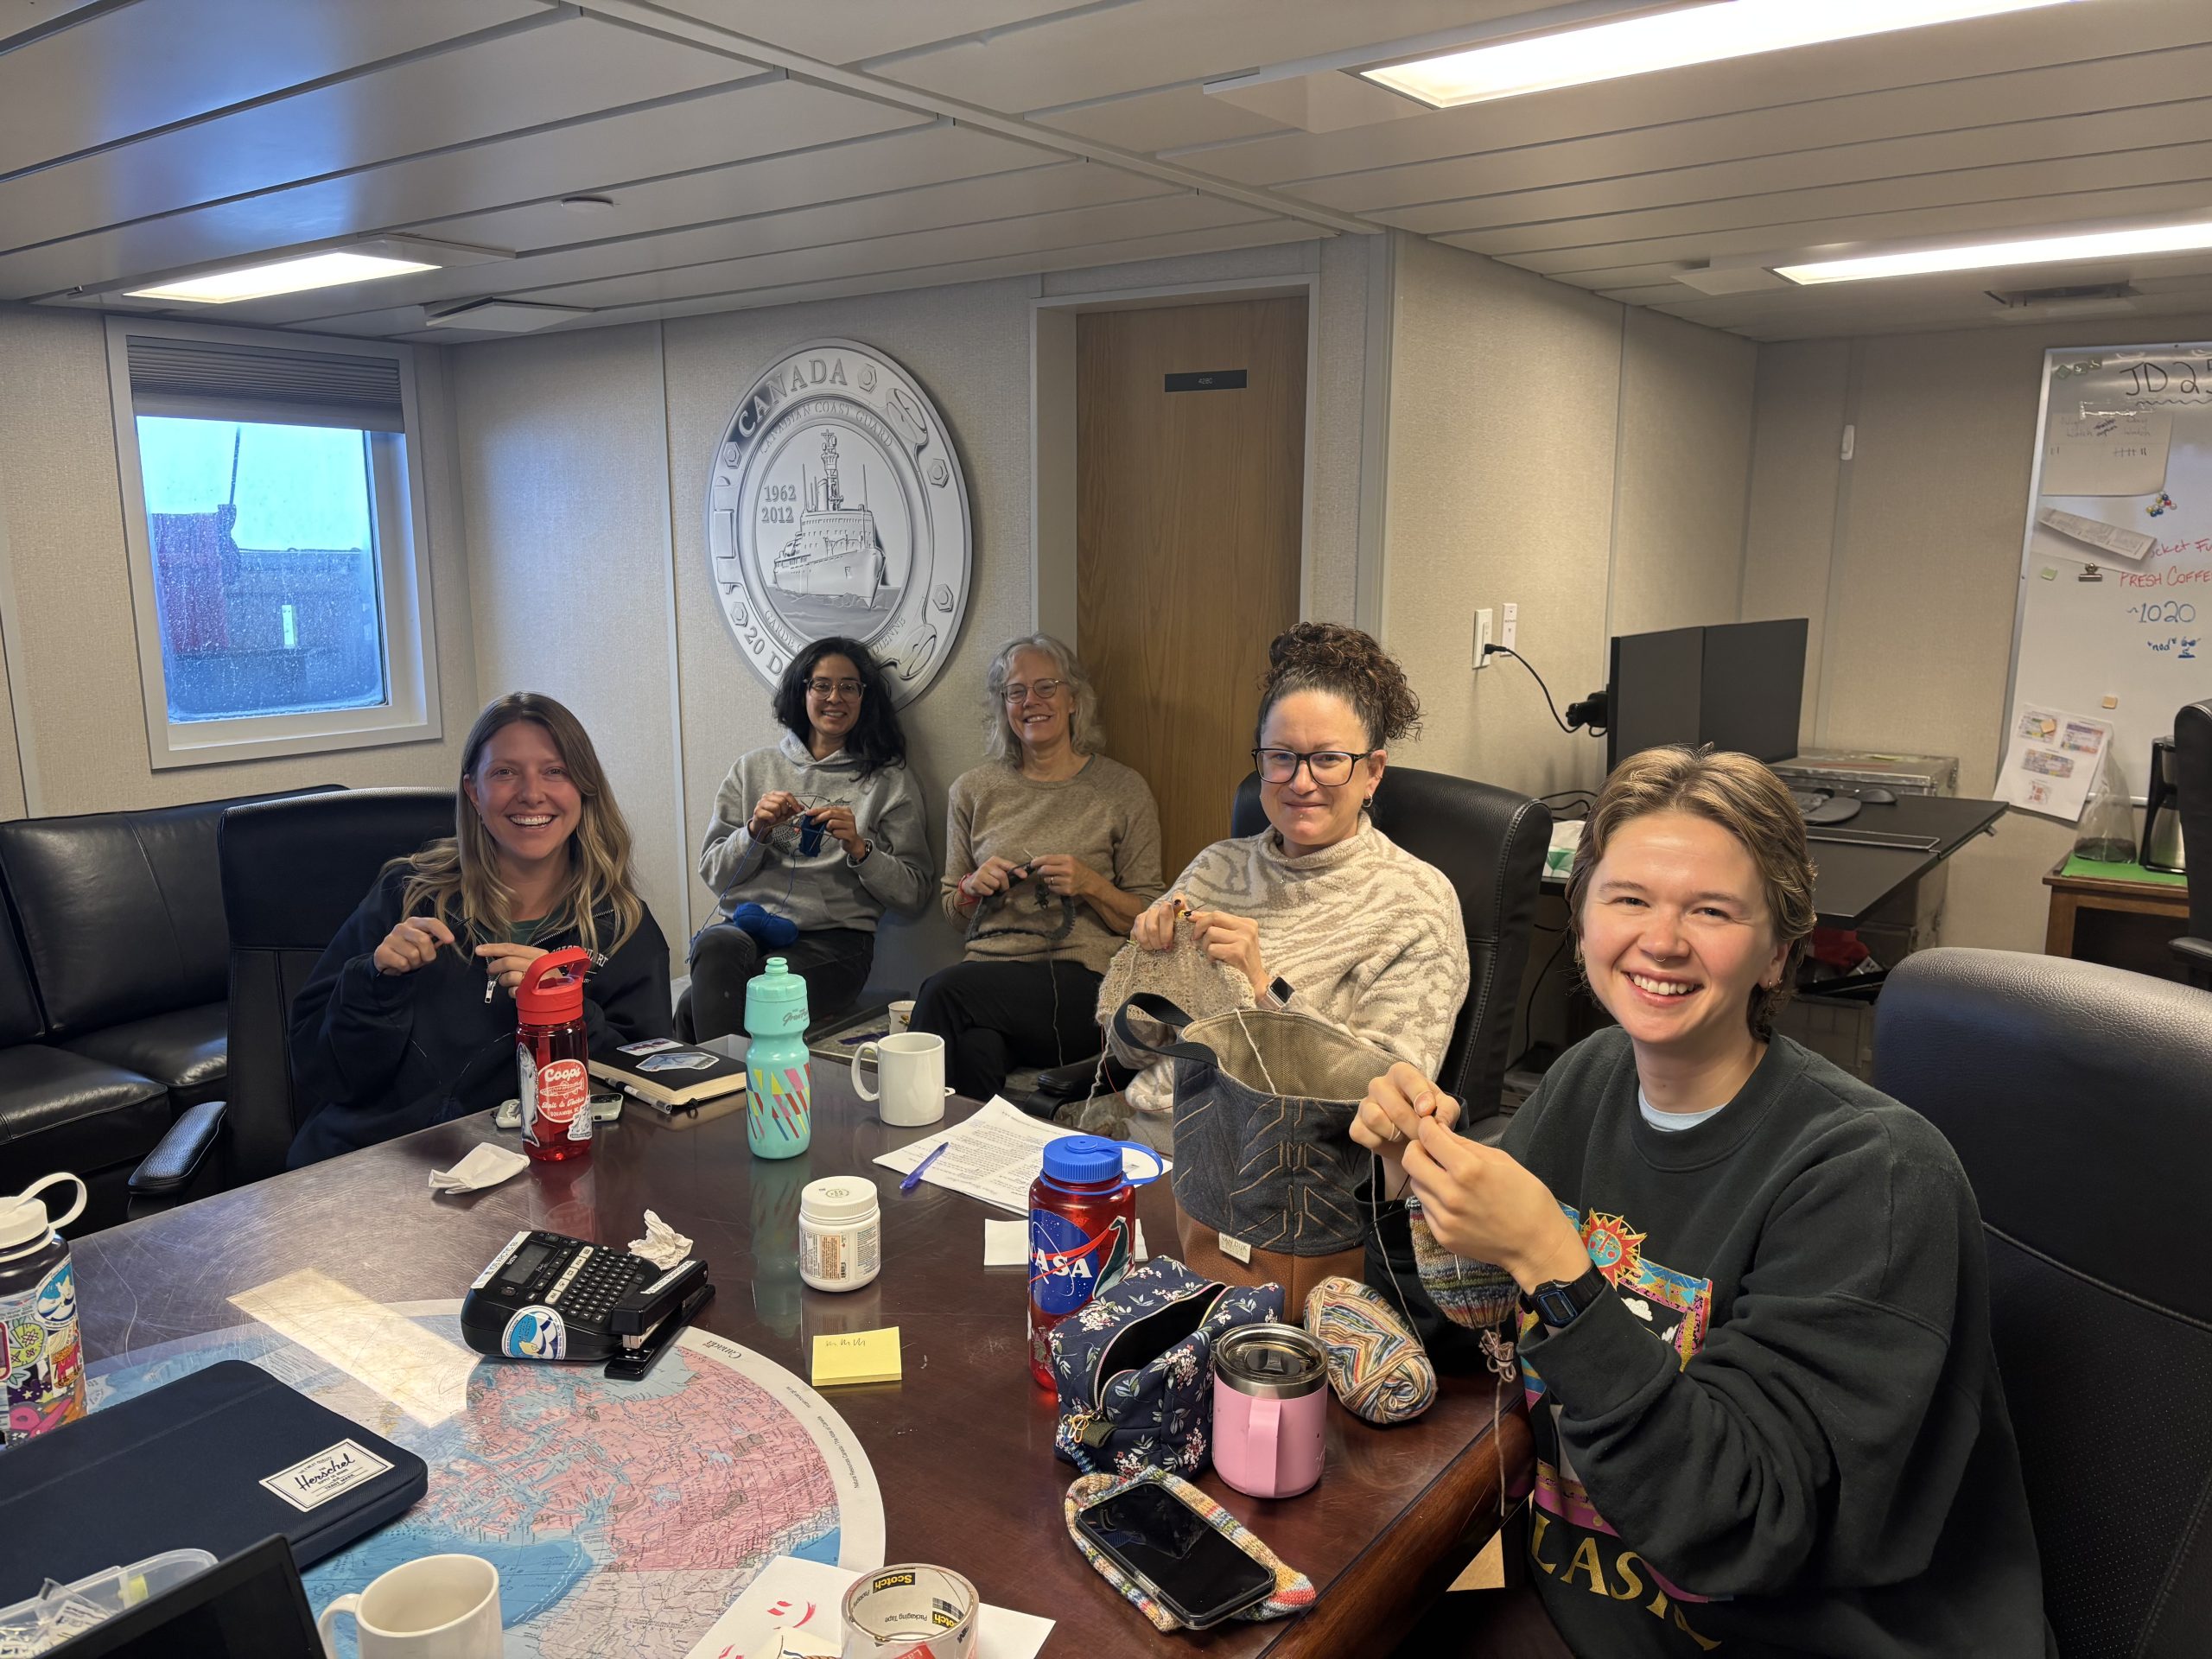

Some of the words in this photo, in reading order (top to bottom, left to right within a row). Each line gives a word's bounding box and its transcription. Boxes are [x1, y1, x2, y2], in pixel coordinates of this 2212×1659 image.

[738, 358, 848, 437] CANADA
[760, 404, 810, 454] CANADIAN
[815, 401, 851, 416] COAST
[855, 410, 893, 448] GUARD
[764, 484, 797, 503] 1962
[761, 505, 795, 524] 2012
[765, 609, 795, 648] GARDE
[744, 626, 766, 656] 20
[544, 1065, 582, 1083] Coop's
[702, 1340, 742, 1359] Canada
[294, 1452, 355, 1491] Herschel
[874, 1573, 912, 1591] Scotch
[884, 1614, 898, 1624] Tape
[899, 1612, 928, 1623] Packaging
[934, 1613, 957, 1627] otch
